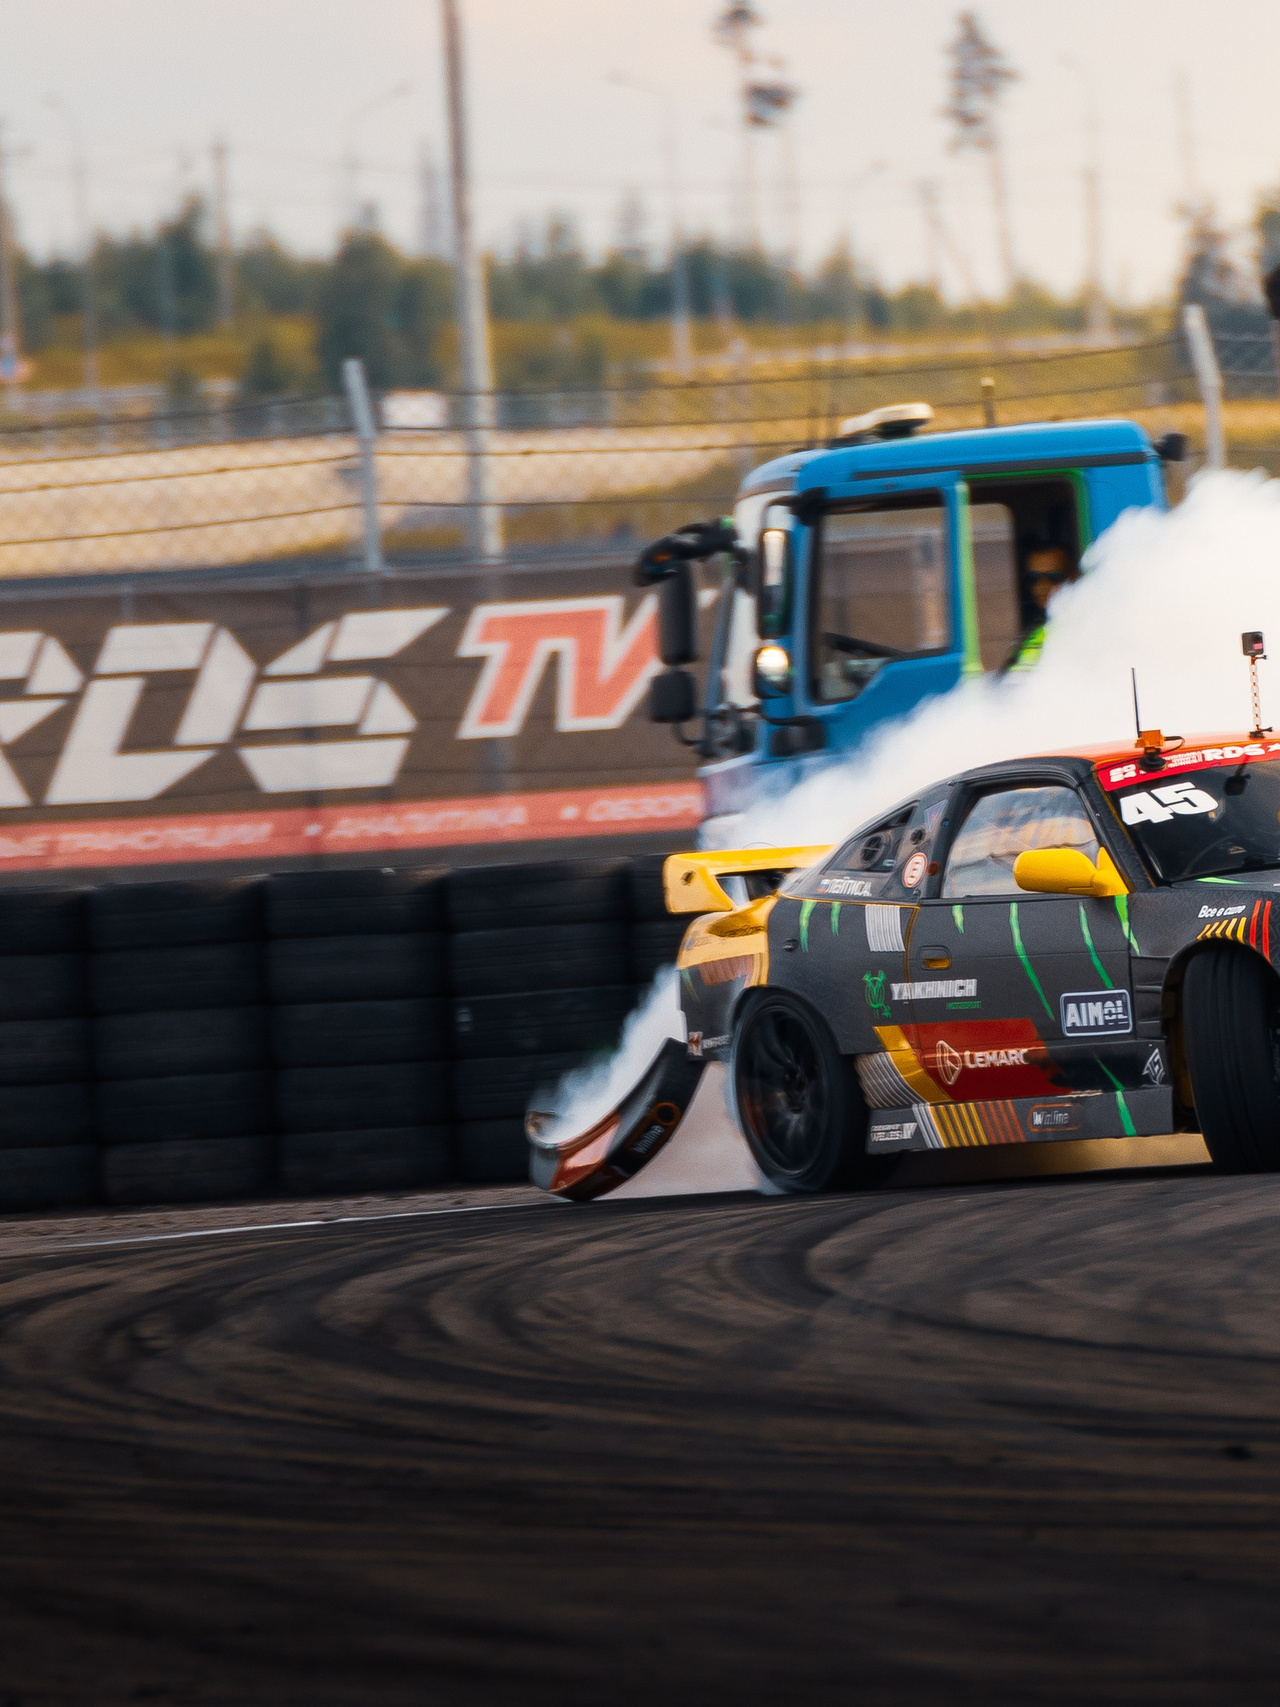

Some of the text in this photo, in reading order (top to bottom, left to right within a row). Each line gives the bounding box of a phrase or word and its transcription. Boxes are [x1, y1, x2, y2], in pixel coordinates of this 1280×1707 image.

[457, 589, 718, 739] TV
[1201, 743, 1266, 761] RDS
[1119, 782, 1219, 826] 45
[1197, 905, 1216, 918] Все
[890, 979, 978, 1001] YAKHNICH
[1066, 1000, 1128, 1027] AIMOL
[964, 1049, 1030, 1068] LEMARC
